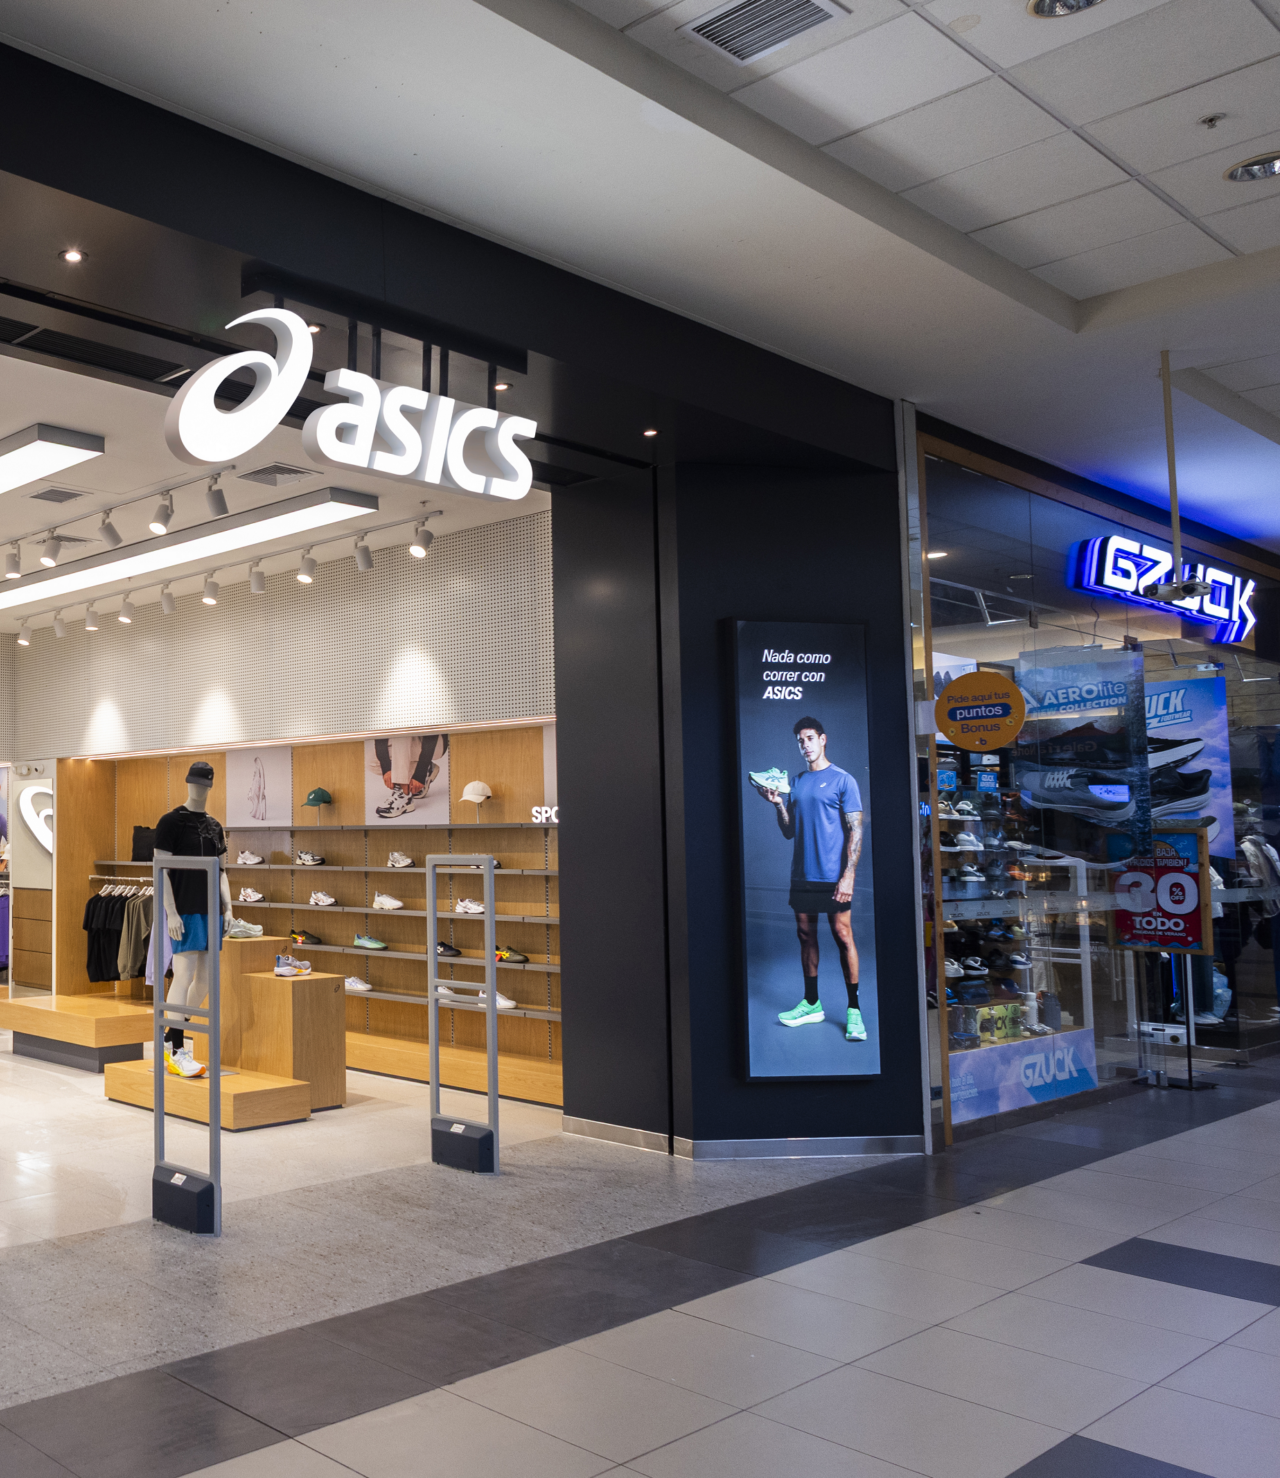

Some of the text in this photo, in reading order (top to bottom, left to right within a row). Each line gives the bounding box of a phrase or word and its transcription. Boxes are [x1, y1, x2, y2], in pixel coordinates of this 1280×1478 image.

[303, 367, 538, 500] asics
[762, 649, 831, 664] Nada como
[763, 670, 825, 682] correr con
[762, 686, 803, 700] ASICS
[947, 695, 969, 704] Pide
[994, 691, 1010, 700] tus
[1044, 683, 1125, 706] AEROlite
[1060, 696, 1127, 713] COLLECTION
[1145, 688, 1186, 718] UCK
[956, 706, 1003, 720] puntos
[961, 723, 1001, 734] Bonus
[1114, 871, 1198, 915] 30
[1132, 916, 1185, 931] TODO
[1021, 1046, 1079, 1089] GZUCK
